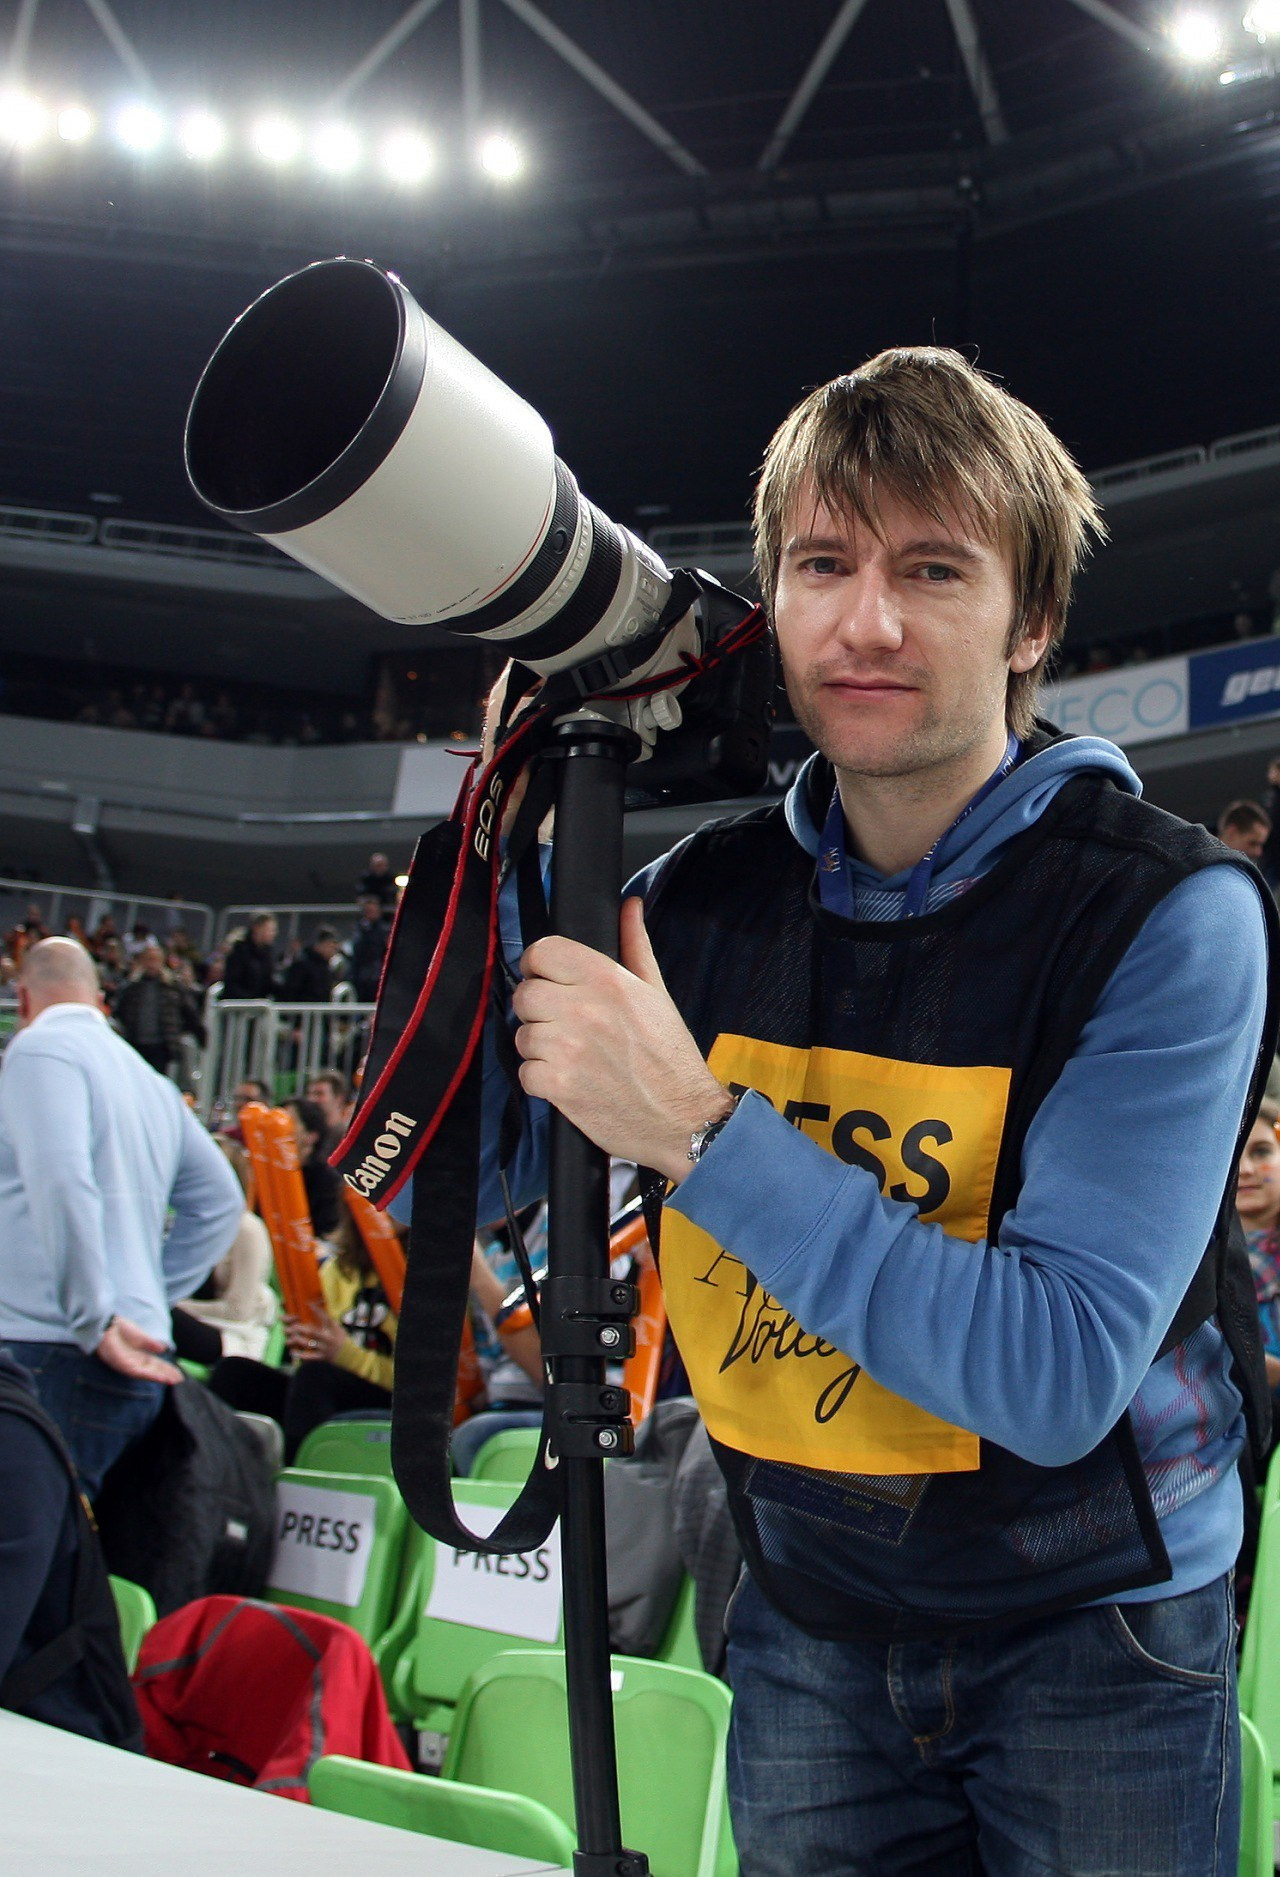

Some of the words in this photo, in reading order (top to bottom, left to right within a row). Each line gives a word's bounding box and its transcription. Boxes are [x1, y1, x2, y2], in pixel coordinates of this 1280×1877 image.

[474, 770, 505, 862] EOS
[342, 1110, 418, 1198] Canon
[280, 1512, 362, 1555] PRESS
